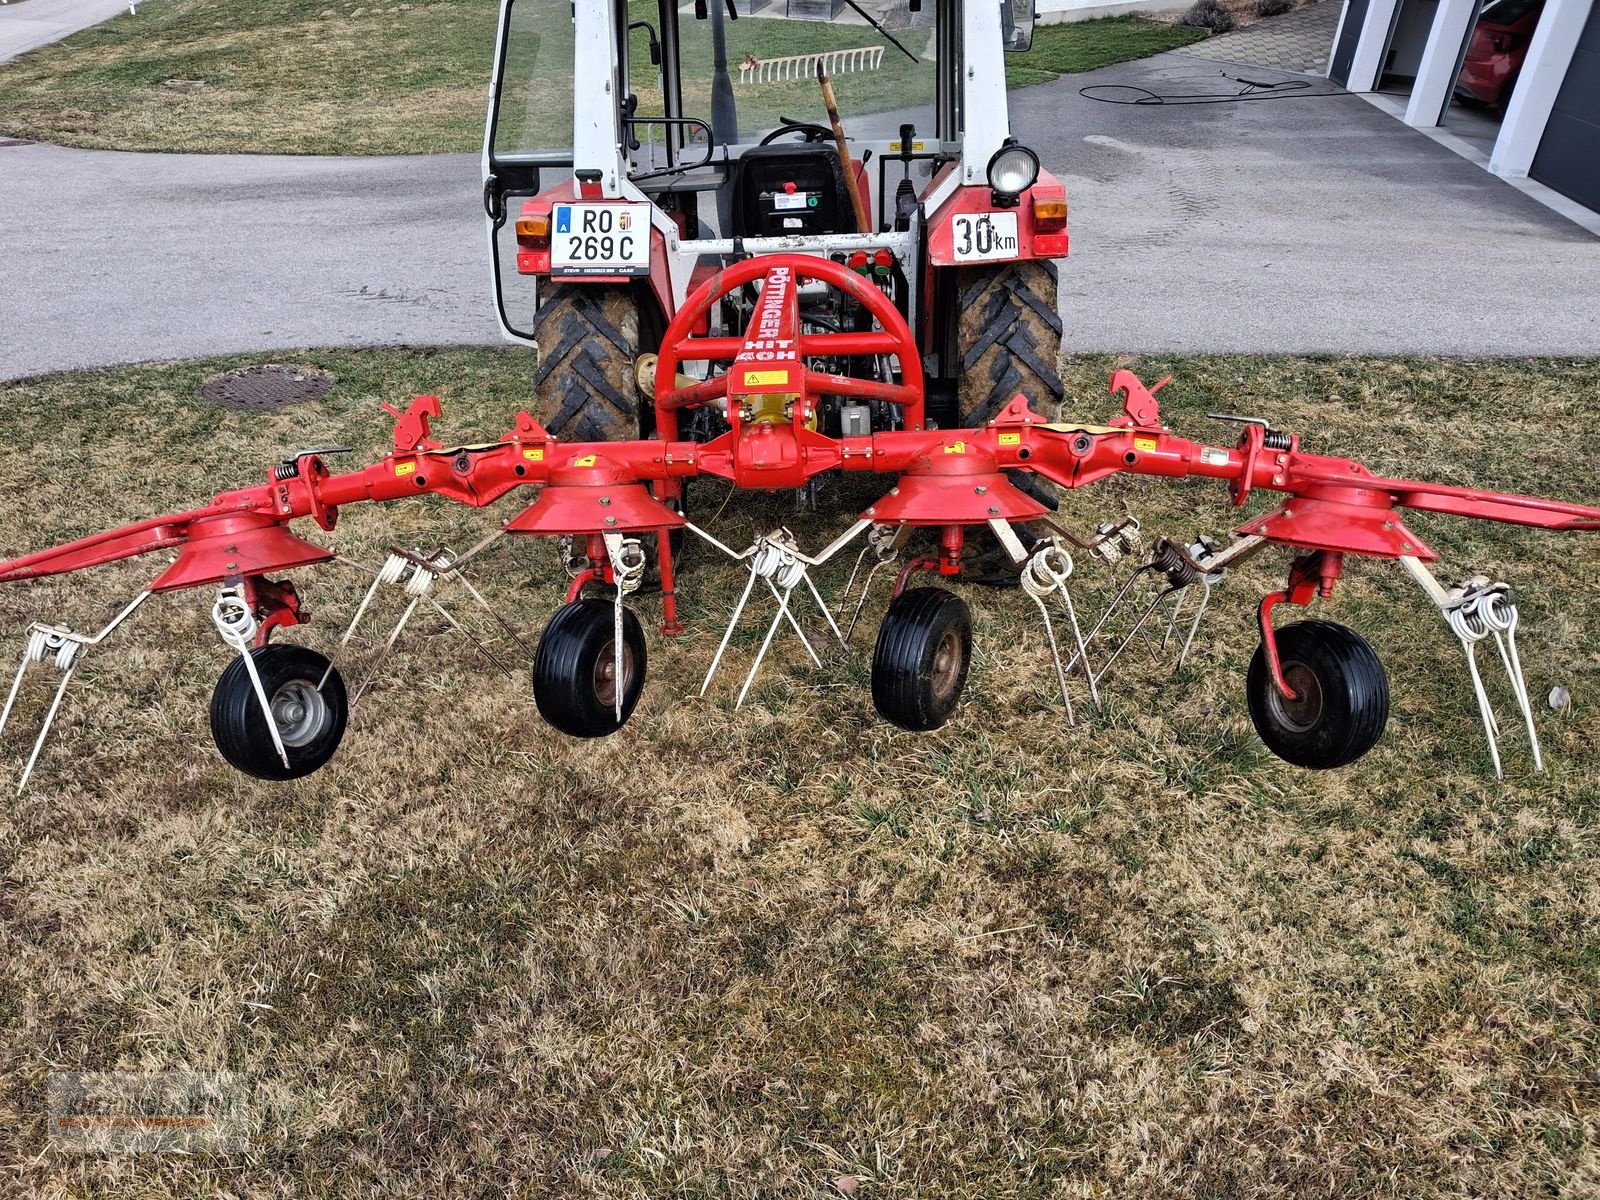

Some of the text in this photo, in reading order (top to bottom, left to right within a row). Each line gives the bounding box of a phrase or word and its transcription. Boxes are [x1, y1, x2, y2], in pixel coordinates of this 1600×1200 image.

[559, 223, 568, 232] A
[583, 209, 613, 234] RO
[568, 235, 634, 260] 269 C
[956, 217, 1017, 255] 30 km
[758, 266, 791, 338] PÖTTINGER
[744, 339, 794, 350] HIT
